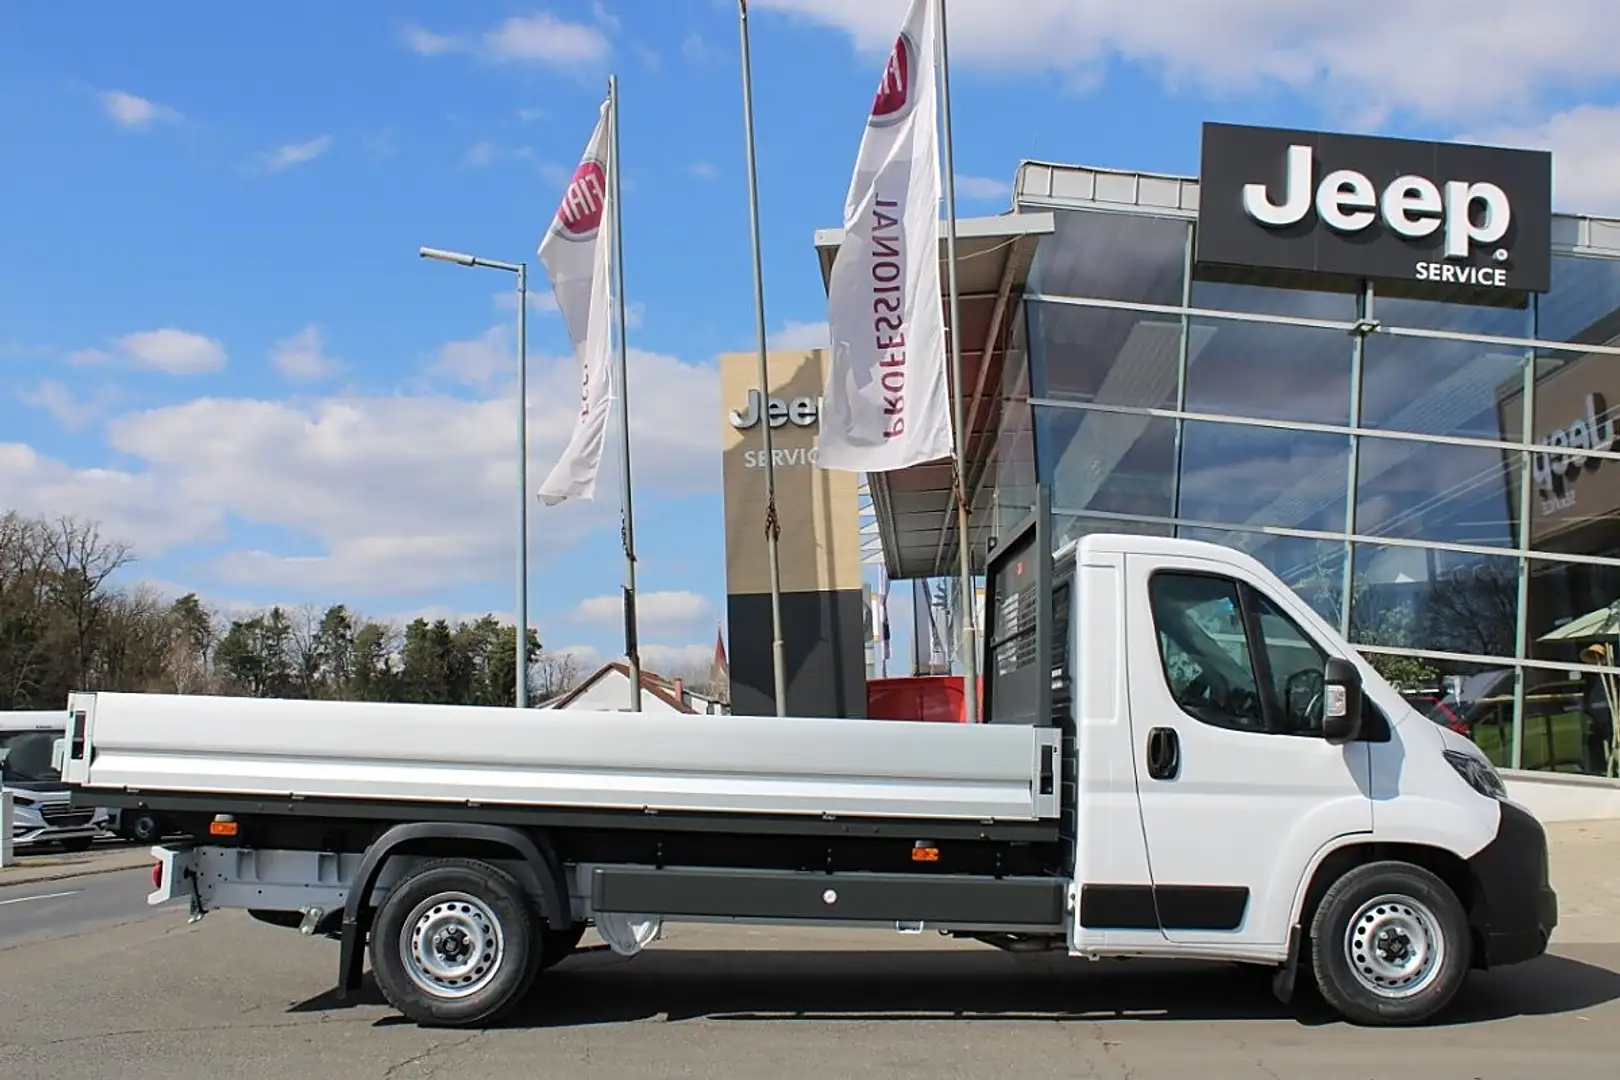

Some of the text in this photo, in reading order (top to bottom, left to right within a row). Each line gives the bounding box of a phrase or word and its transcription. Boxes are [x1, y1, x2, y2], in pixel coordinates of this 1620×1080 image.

[1243, 144, 1511, 260] Jeep
[1415, 262, 1507, 287] SERVICE
[729, 389, 818, 429] Jee
[744, 446, 819, 468] SERVIC
